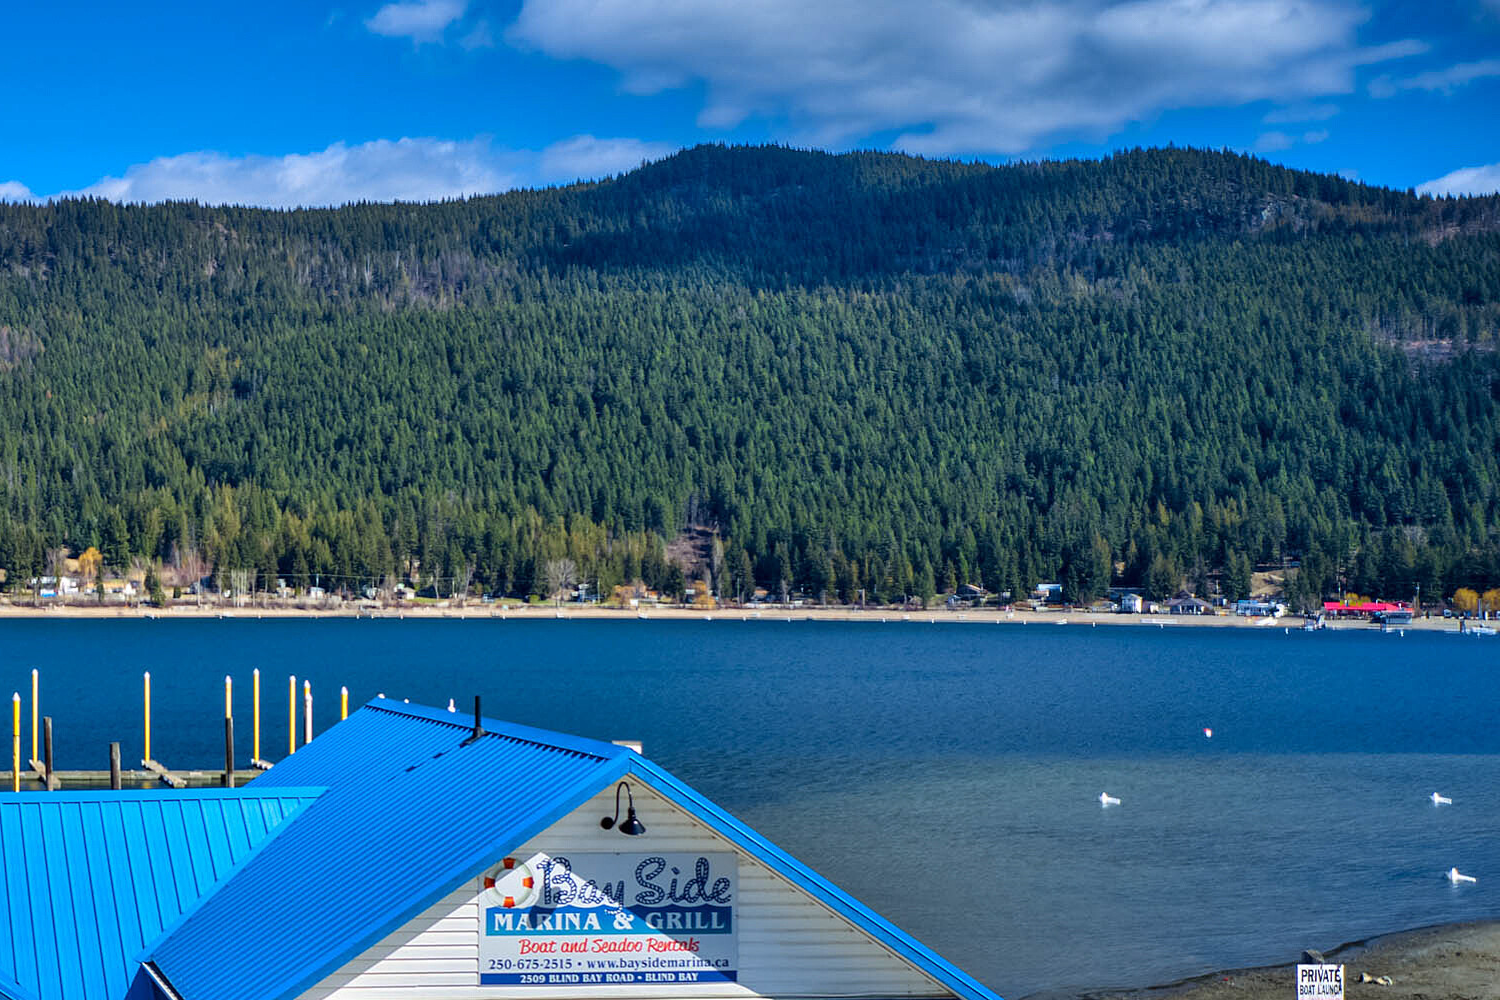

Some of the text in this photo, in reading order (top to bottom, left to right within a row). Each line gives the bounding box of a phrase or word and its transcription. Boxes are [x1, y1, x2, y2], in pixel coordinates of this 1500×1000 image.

[537, 857, 731, 913] Bay Side
[494, 912, 725, 931] MARINA & GRILL
[519, 937, 699, 955] Boat and Seadoo Rentals
[489, 957, 729, 971] 250-675-2515 www.baysidemarina.ca
[520, 972, 698, 983] 2509 BLIND BAY ROAD BLIND BAY
[1301, 969, 1341, 982] PRIVATE
[1300, 985, 1315, 995] BOAT
